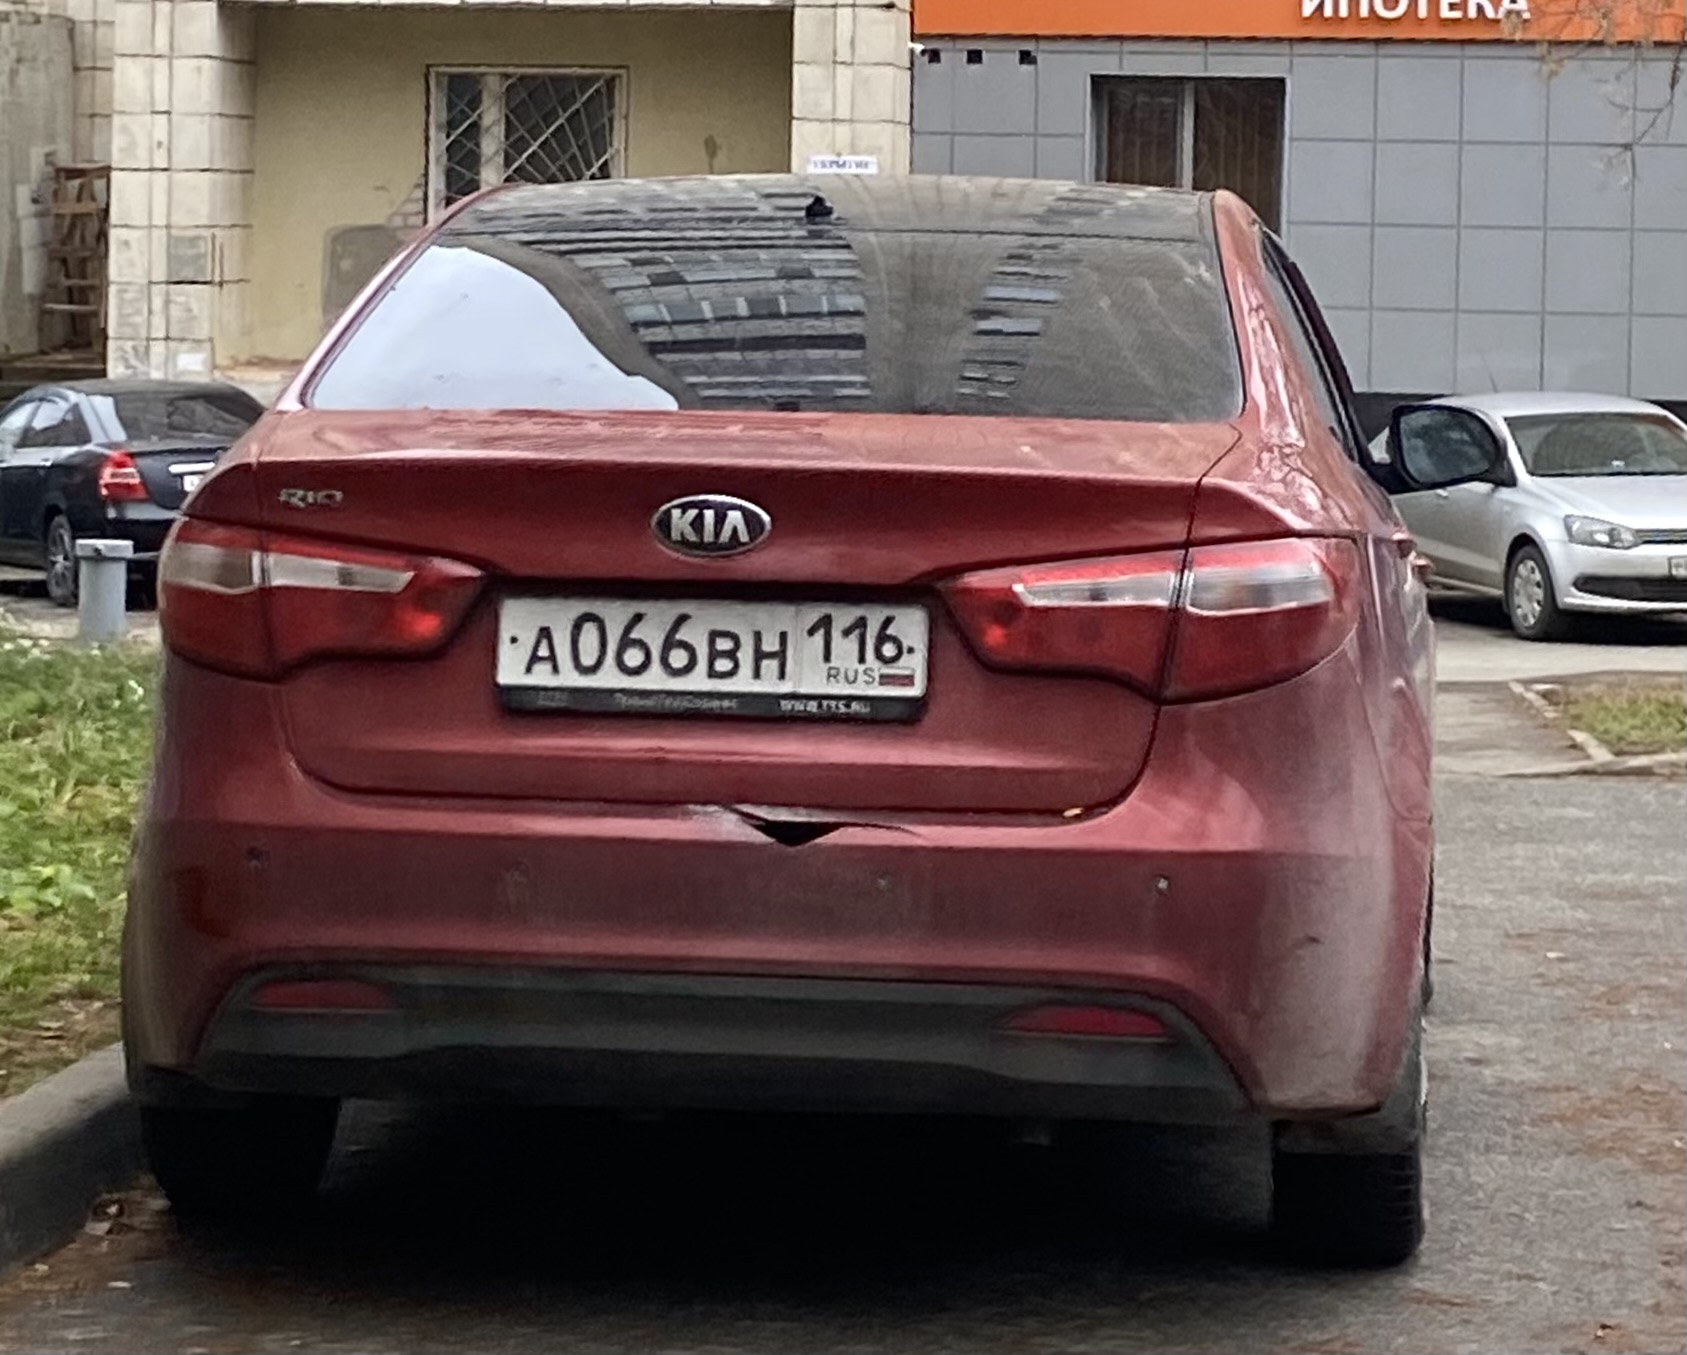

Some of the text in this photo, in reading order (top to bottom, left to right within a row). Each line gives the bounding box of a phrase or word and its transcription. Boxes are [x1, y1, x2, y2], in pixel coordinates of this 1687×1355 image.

[671, 508, 750, 543] KIA
[806, 613, 904, 665] 116
[827, 666, 877, 685] RUS
